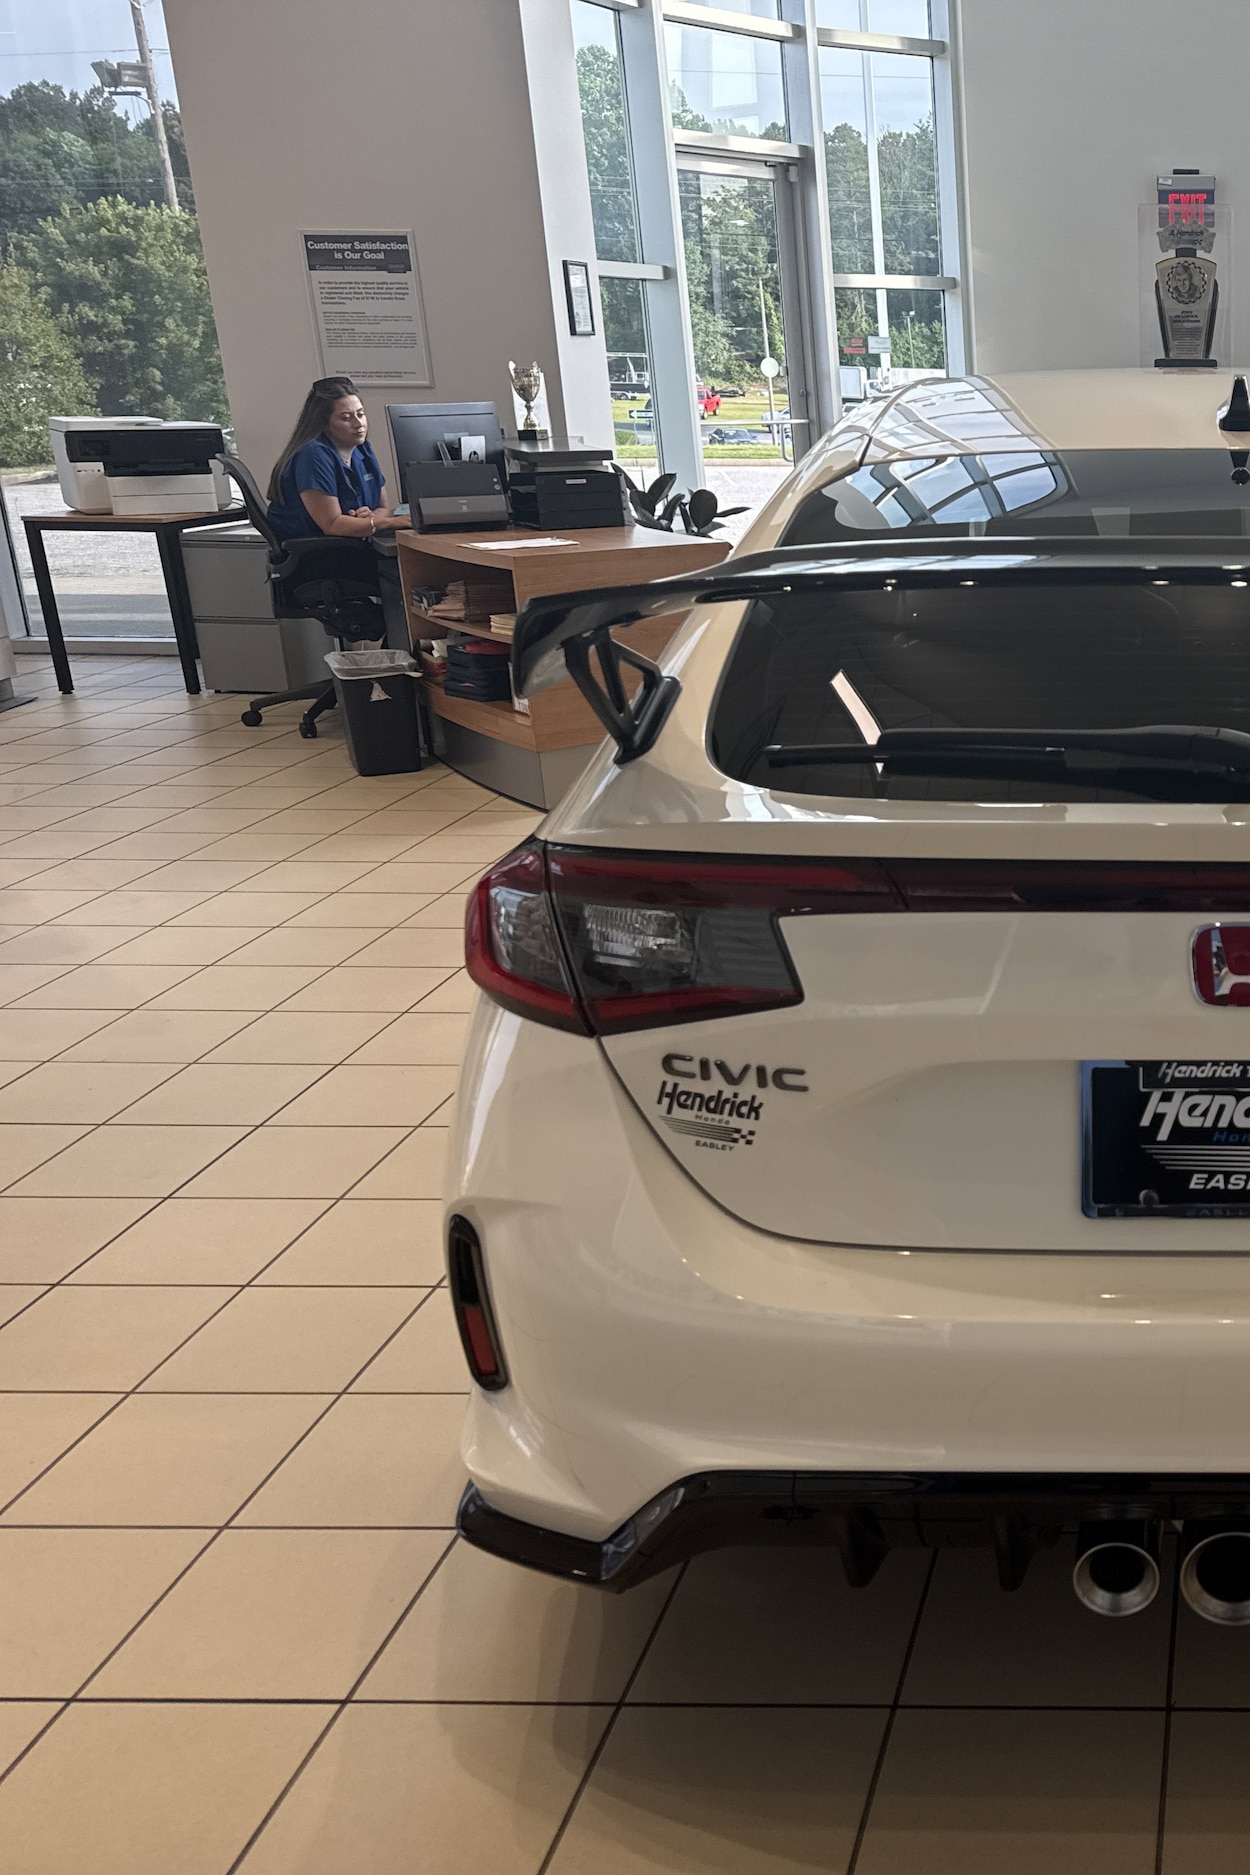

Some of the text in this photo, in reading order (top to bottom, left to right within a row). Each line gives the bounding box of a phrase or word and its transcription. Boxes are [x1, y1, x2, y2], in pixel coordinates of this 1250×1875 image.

[1169, 193, 1207, 225] EXIT
[307, 241, 409, 250] Customer Satisfaction
[334, 251, 385, 260] is Our Goal
[661, 1052, 810, 1093] CIVIC
[1158, 1061, 1242, 1084] Hendrick
[656, 1080, 765, 1121] Hendrick
[695, 1113, 731, 1126] Honda
[695, 1139, 736, 1152] EASLEY
